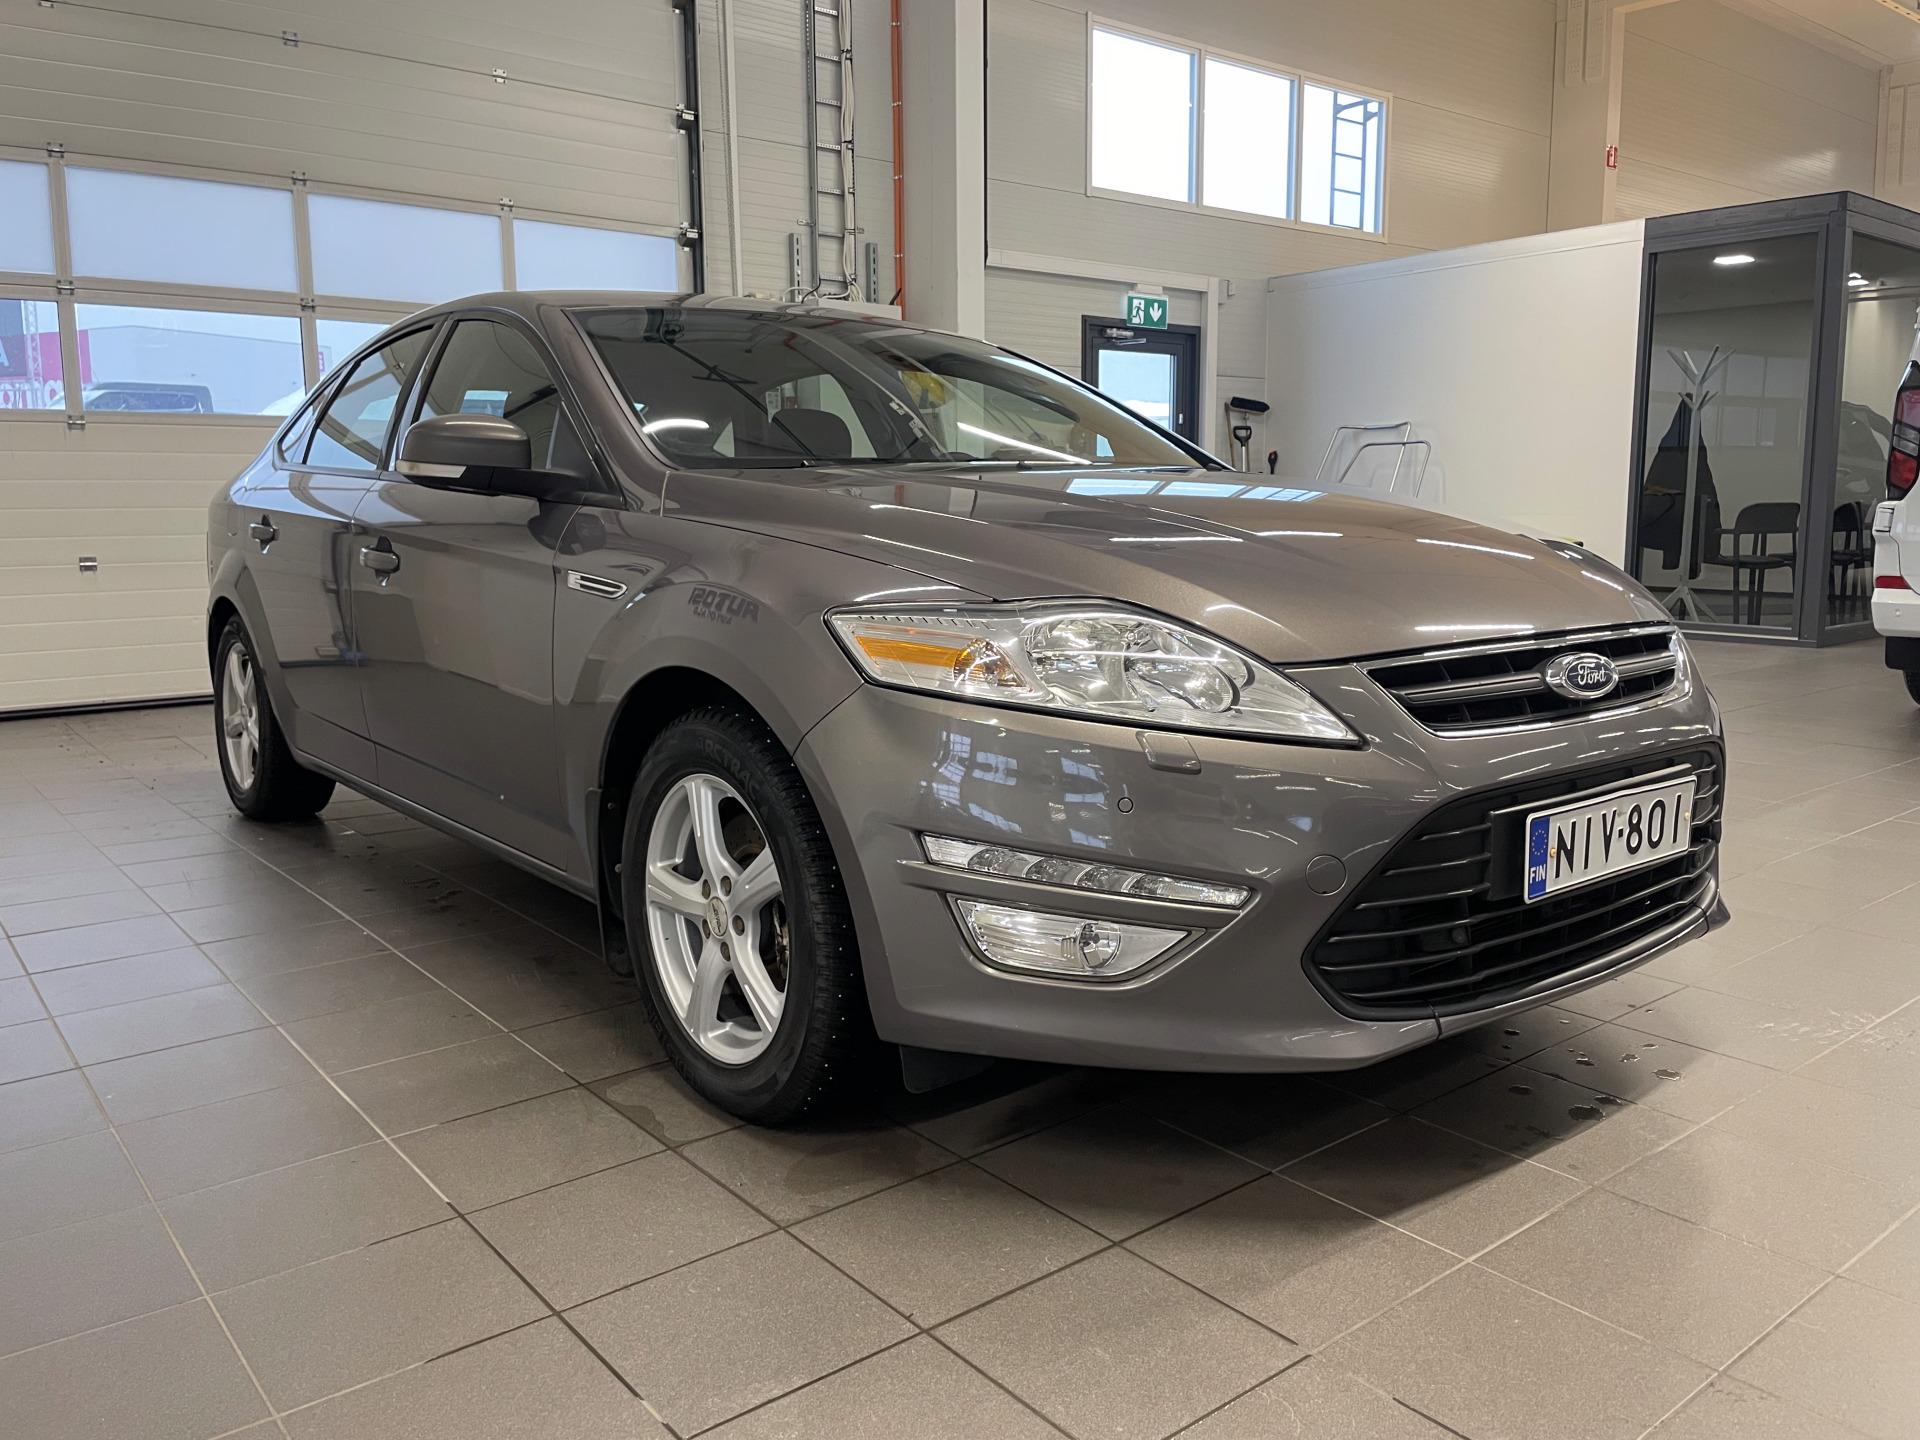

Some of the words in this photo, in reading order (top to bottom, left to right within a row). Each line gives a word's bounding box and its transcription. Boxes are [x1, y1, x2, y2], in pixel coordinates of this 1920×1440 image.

[1578, 663, 1606, 685] Ford
[1554, 792, 1683, 880] NIV-801
[1529, 863, 1547, 884] FIN
